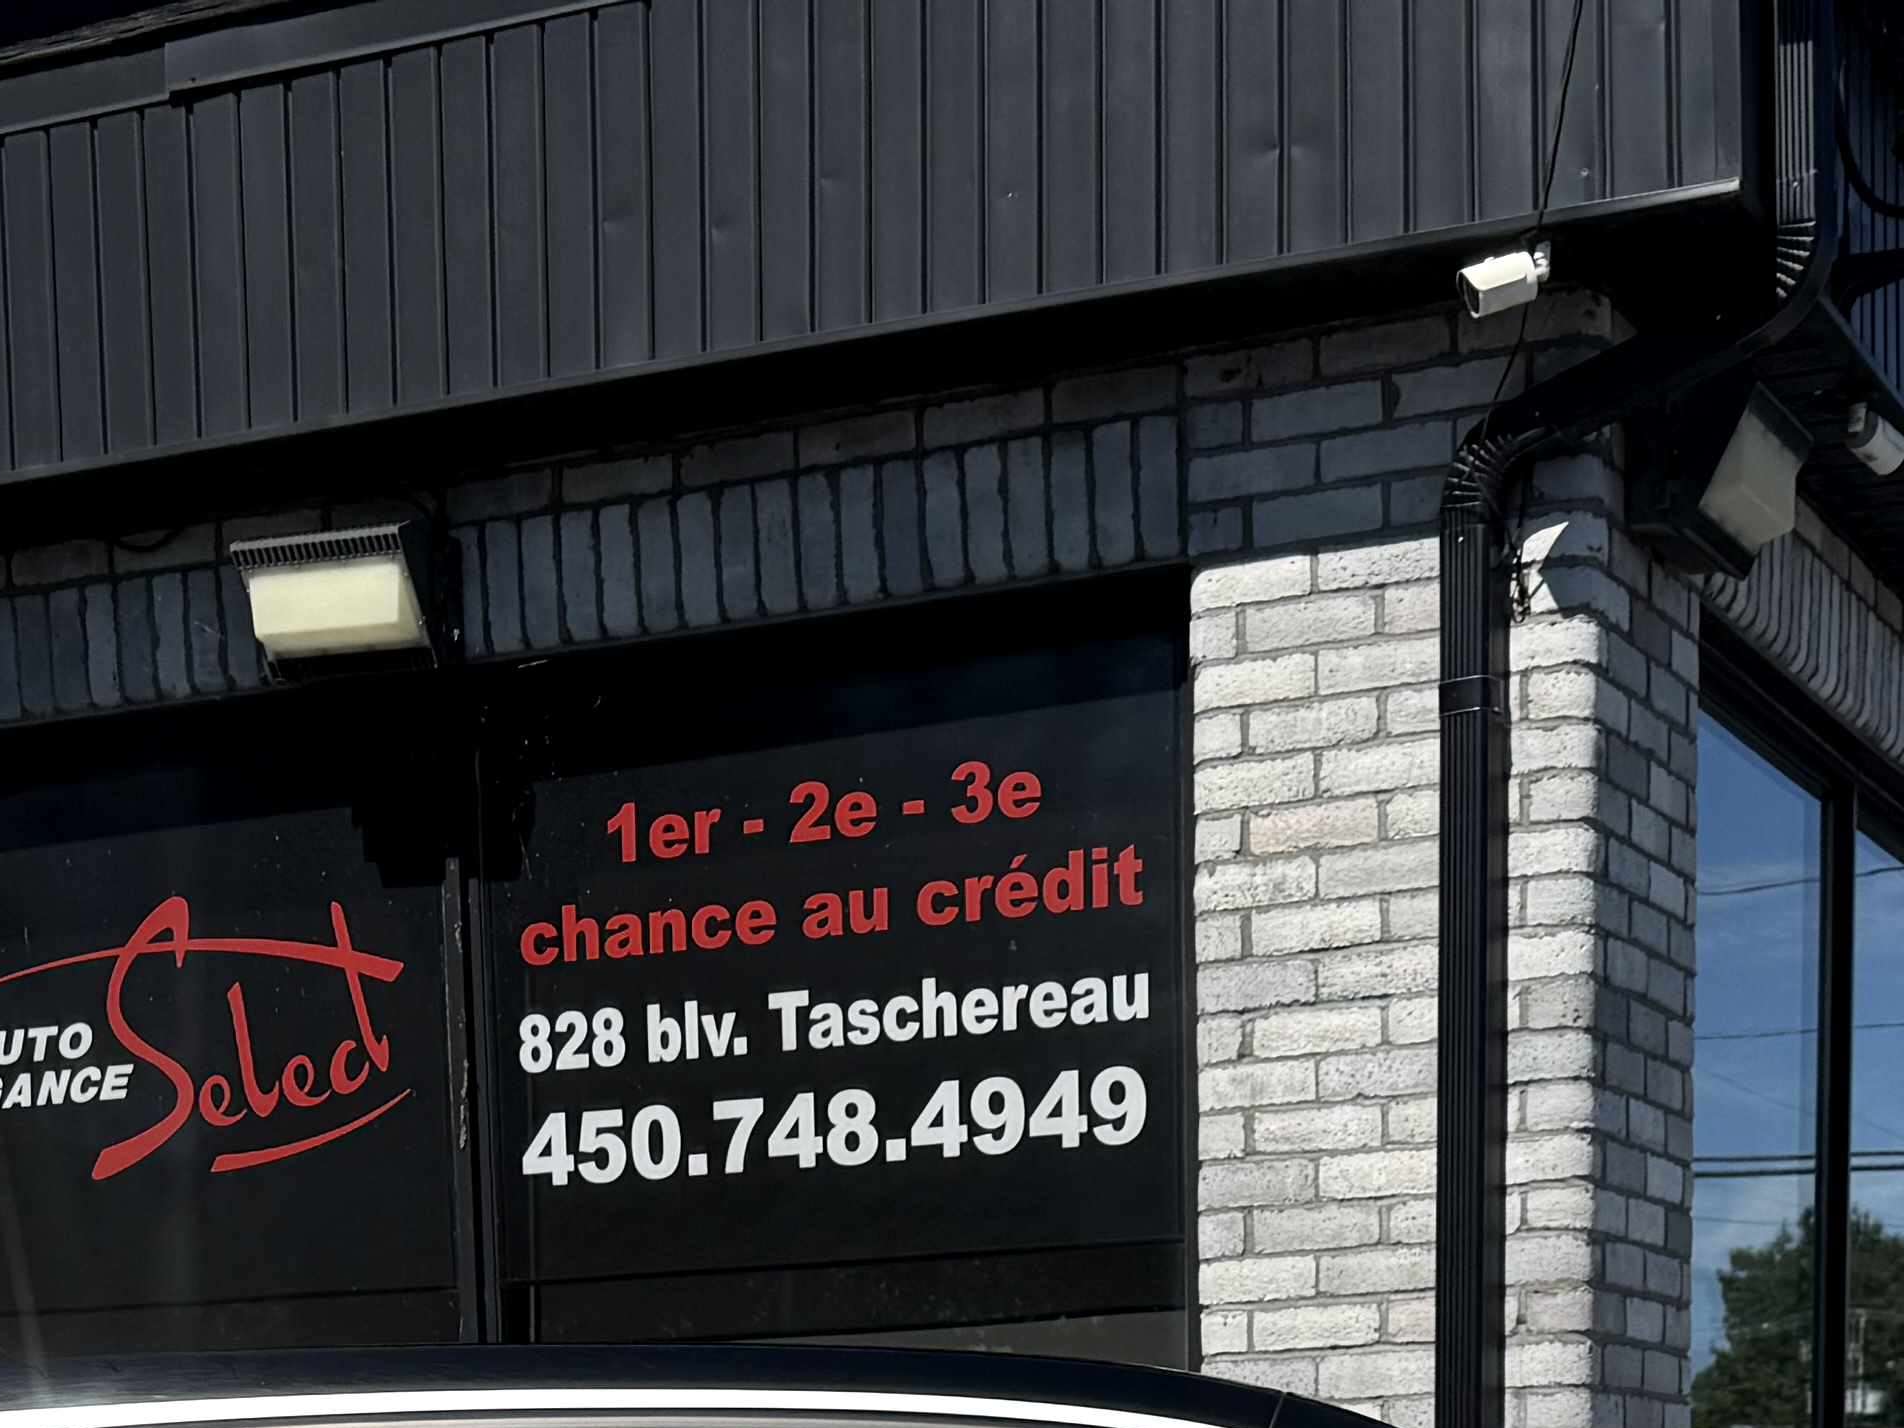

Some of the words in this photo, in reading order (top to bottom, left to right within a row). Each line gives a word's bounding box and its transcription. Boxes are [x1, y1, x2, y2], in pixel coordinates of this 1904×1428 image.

[607, 802, 721, 863] 1er
[789, 781, 877, 843] 2e
[952, 761, 1042, 824] 3e
[520, 900, 777, 966] chance
[802, 887, 889, 940] au
[916, 847, 1144, 926] crédit
[90, 895, 406, 1181] Select
[519, 1007, 626, 1074] 828
[646, 1000, 748, 1063] blv.
[767, 972, 1150, 1052] Taschereau
[522, 1065, 1147, 1186] 450.748.4949
